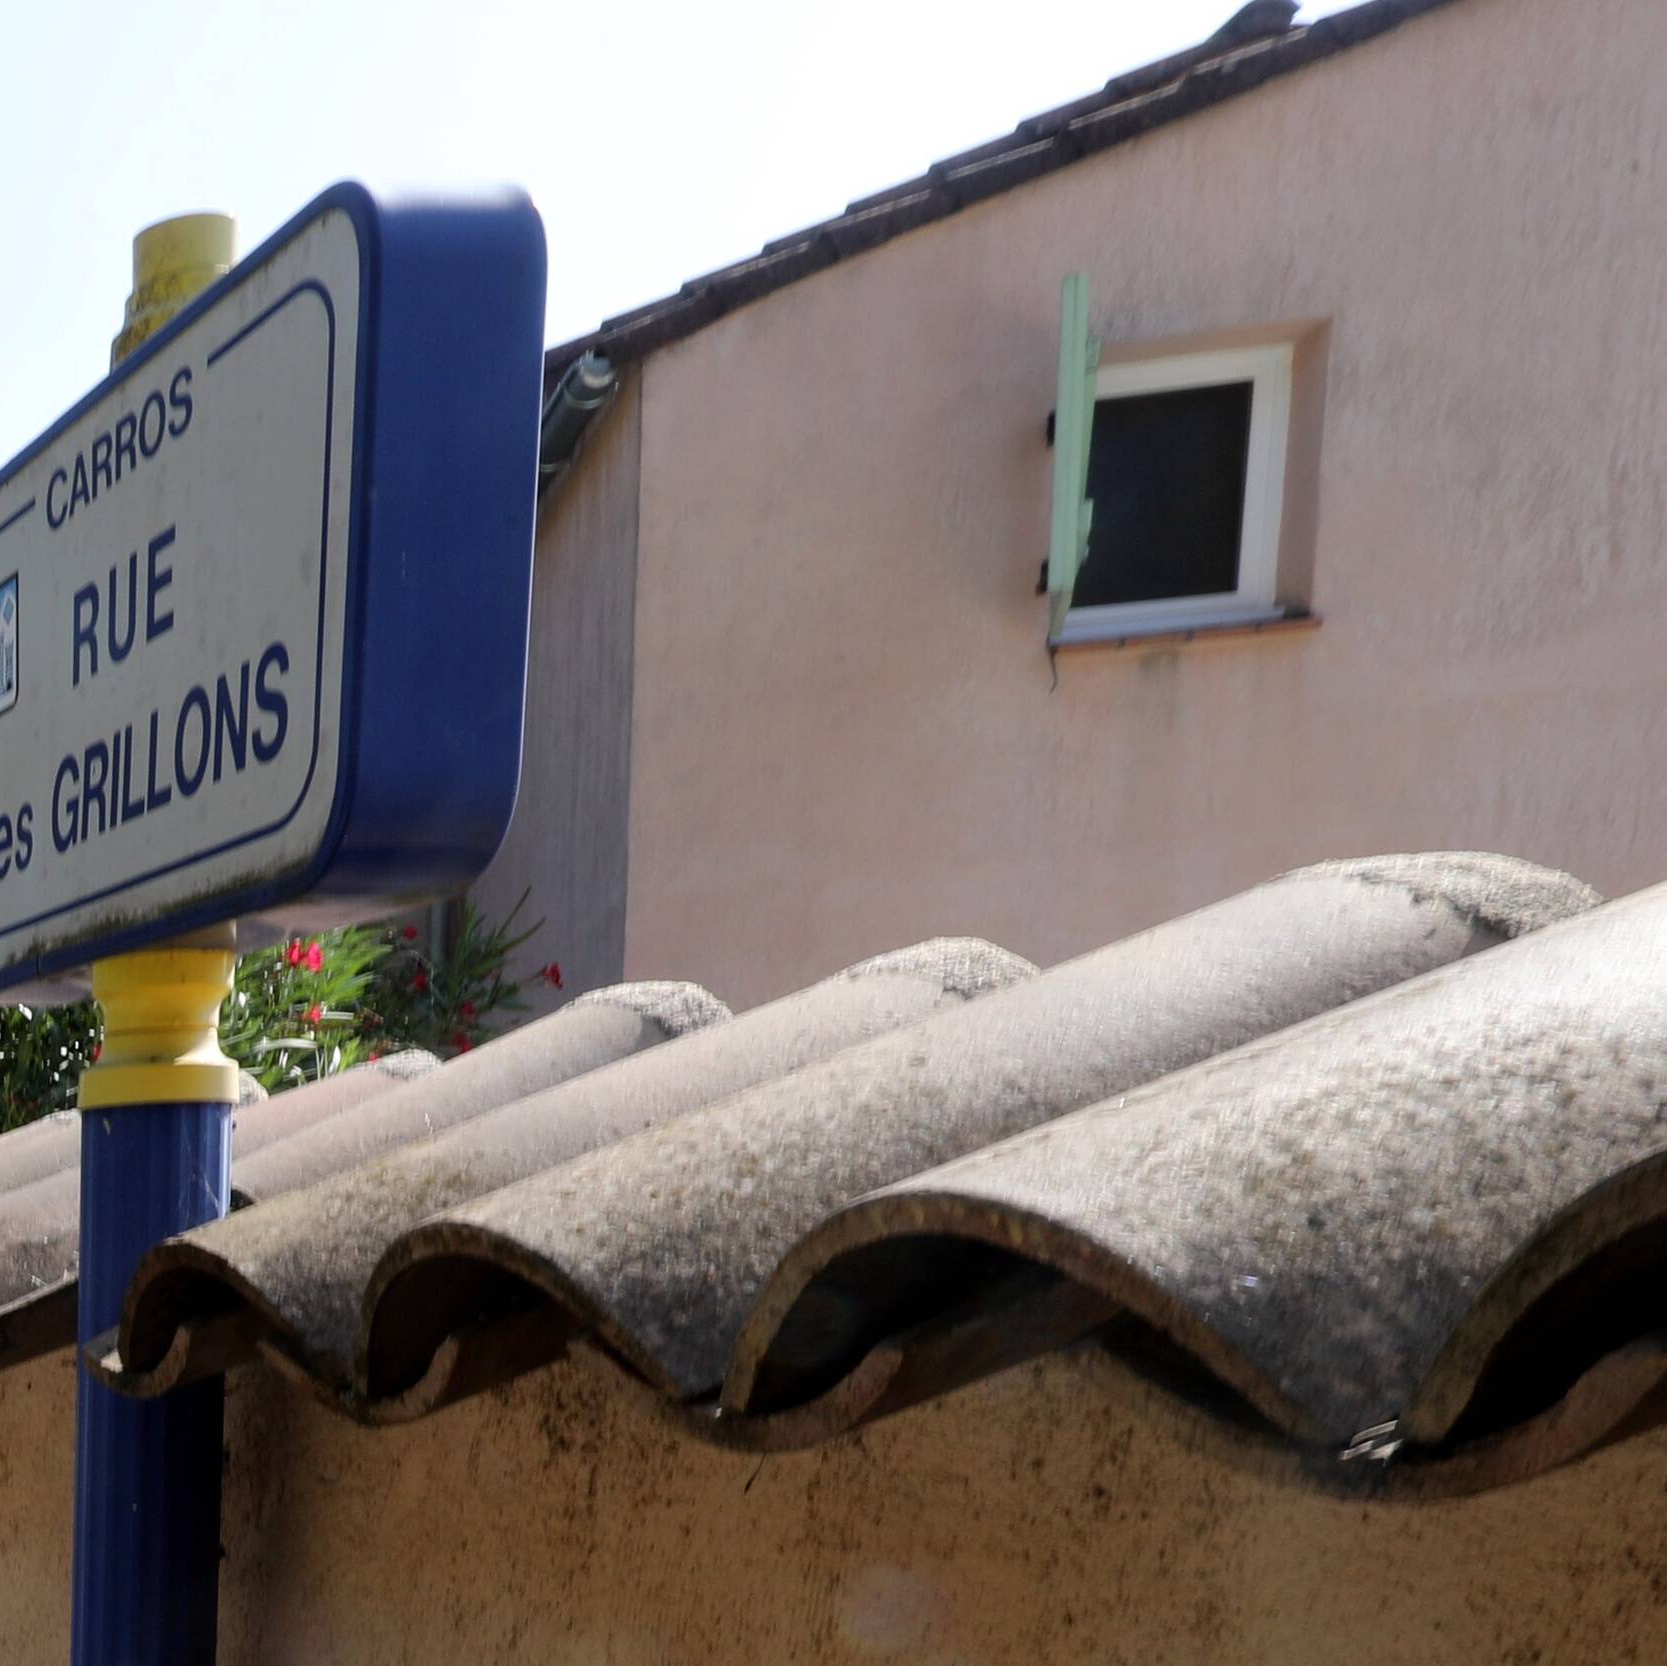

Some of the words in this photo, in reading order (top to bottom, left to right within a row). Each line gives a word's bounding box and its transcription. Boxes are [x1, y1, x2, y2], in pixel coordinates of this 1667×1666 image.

[46, 366, 193, 530] CARROS
[72, 523, 176, 688] RUE
[51, 640, 290, 854] GRILLONS
